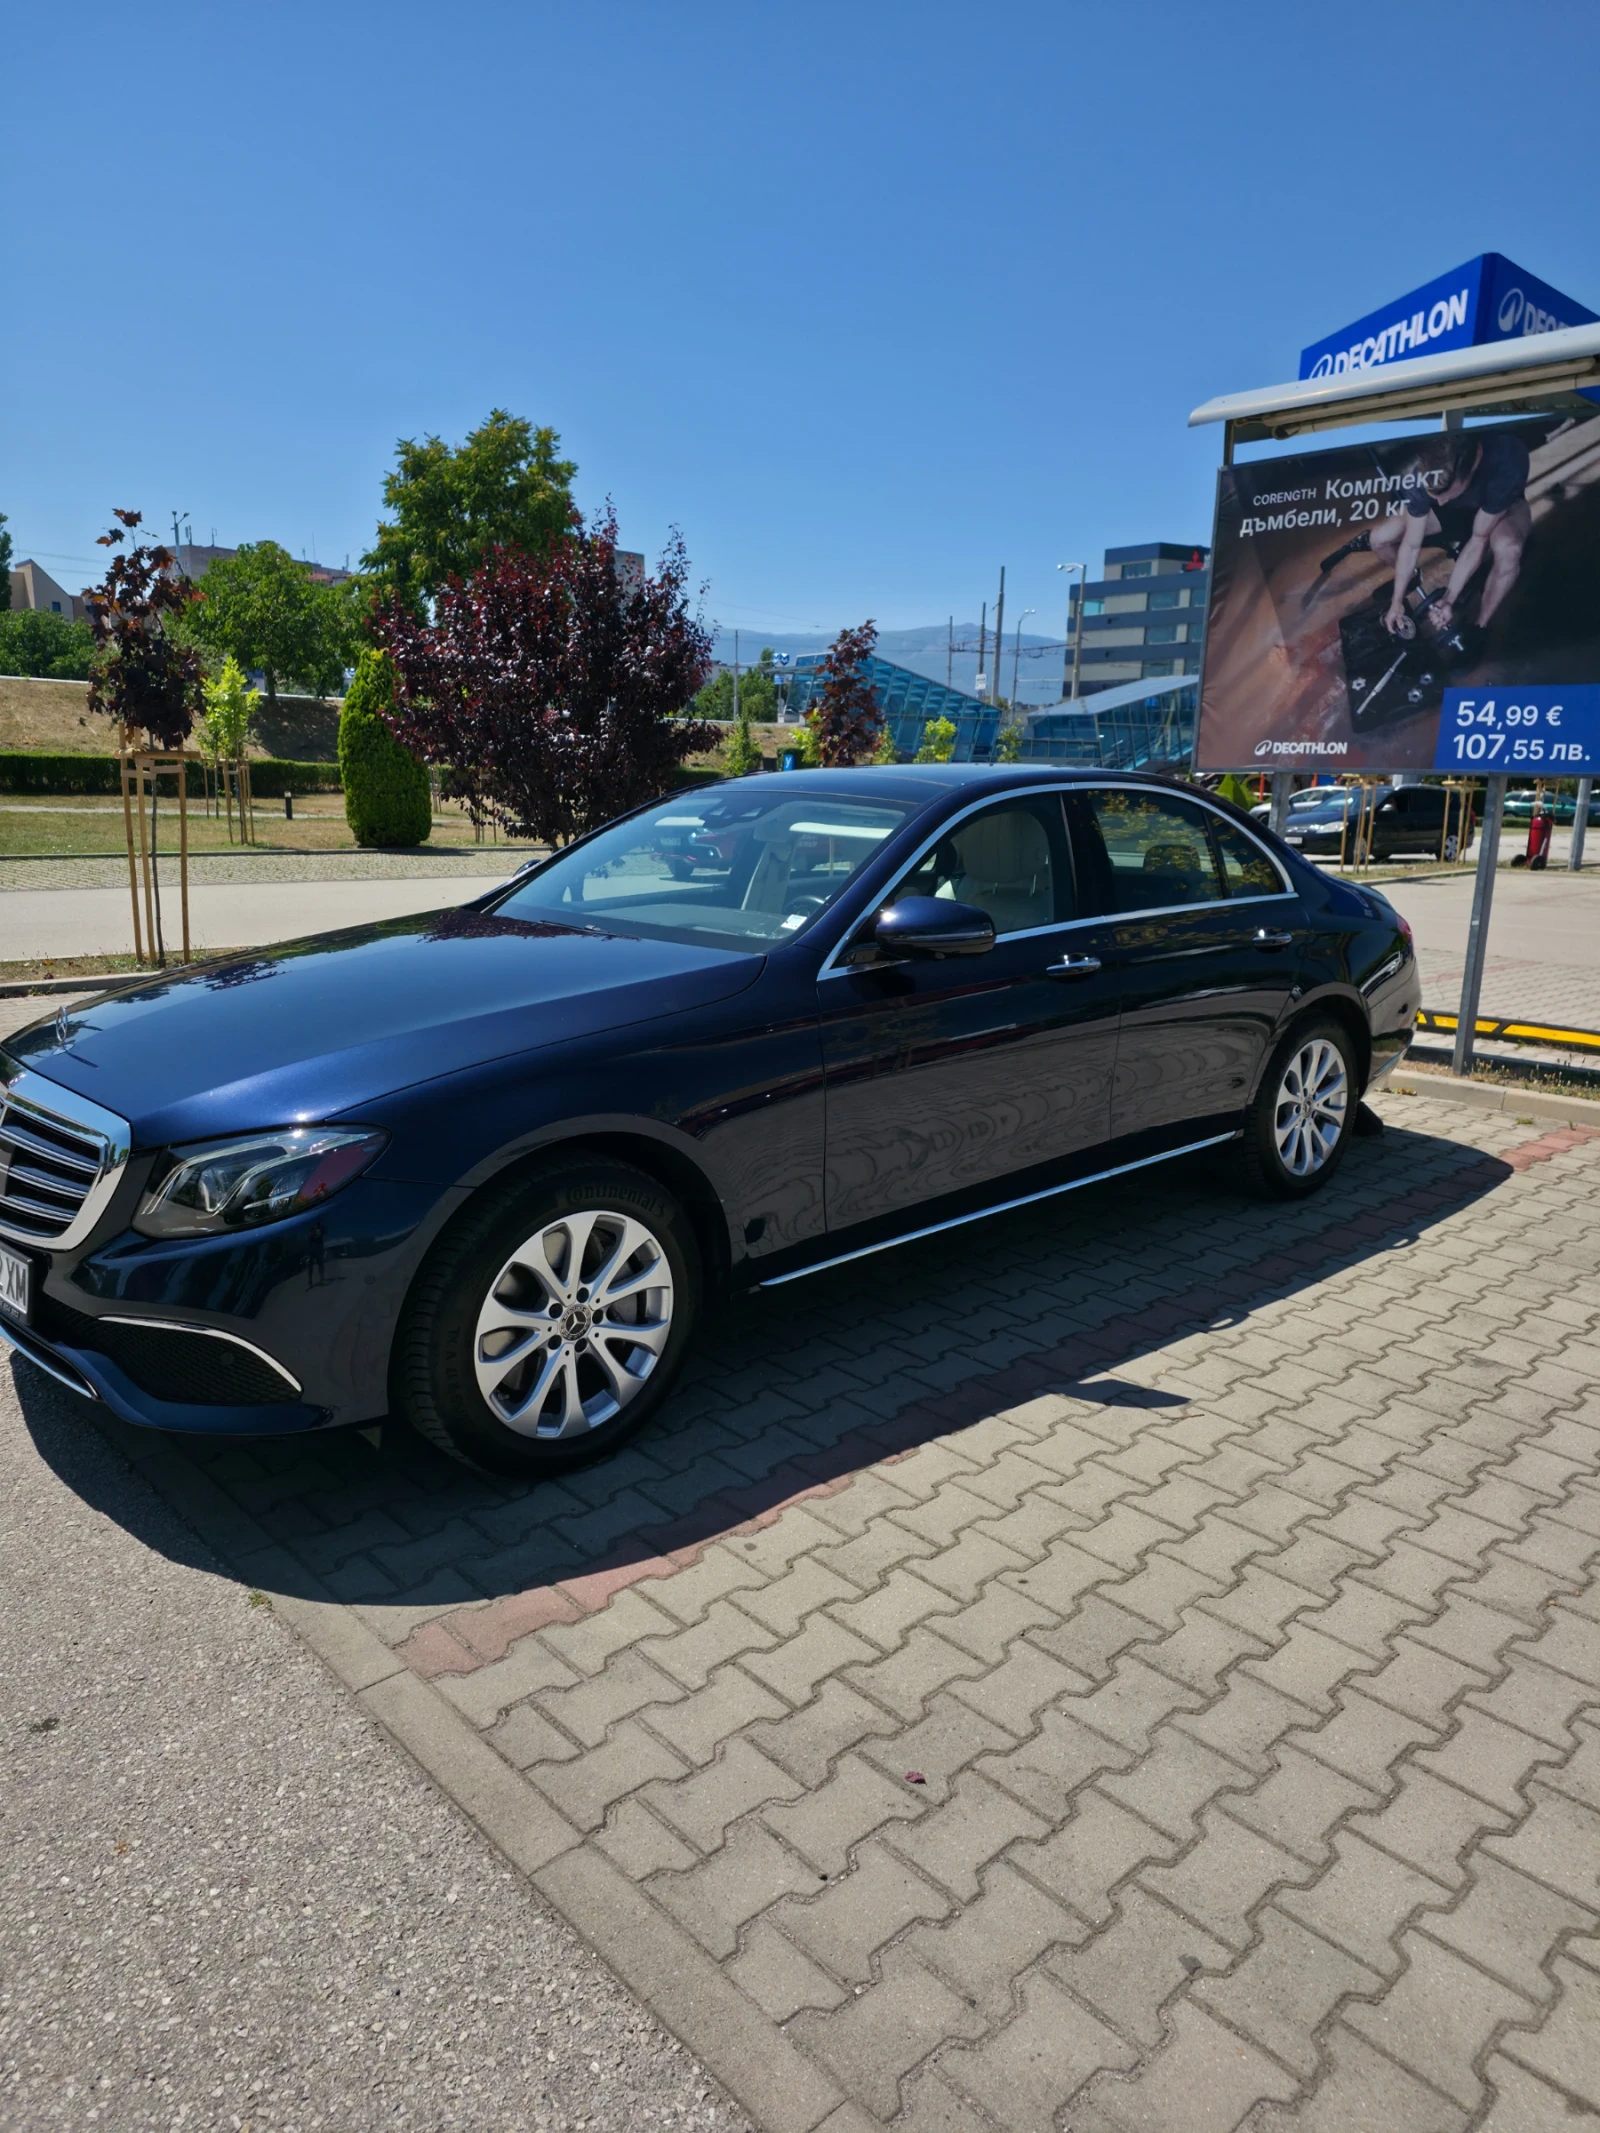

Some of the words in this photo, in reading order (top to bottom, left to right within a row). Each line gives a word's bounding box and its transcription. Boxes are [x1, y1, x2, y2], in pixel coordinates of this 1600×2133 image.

[1334, 289, 1469, 374] DECATHLON
[1252, 488, 1317, 506] CORENGTH
[1325, 470, 1444, 500] Комплект
[1239, 508, 1343, 537] дъмбели,
[1349, 499, 1379, 522] 20
[1385, 499, 1411, 517] кг
[1456, 700, 1539, 731] 54,99
[1545, 705, 1564, 726] €
[1272, 741, 1348, 755] DECATHLON
[1453, 733, 1545, 764] 107,55
[1549, 743, 1591, 761] лв.
[5, 1256, 26, 1307] XM
